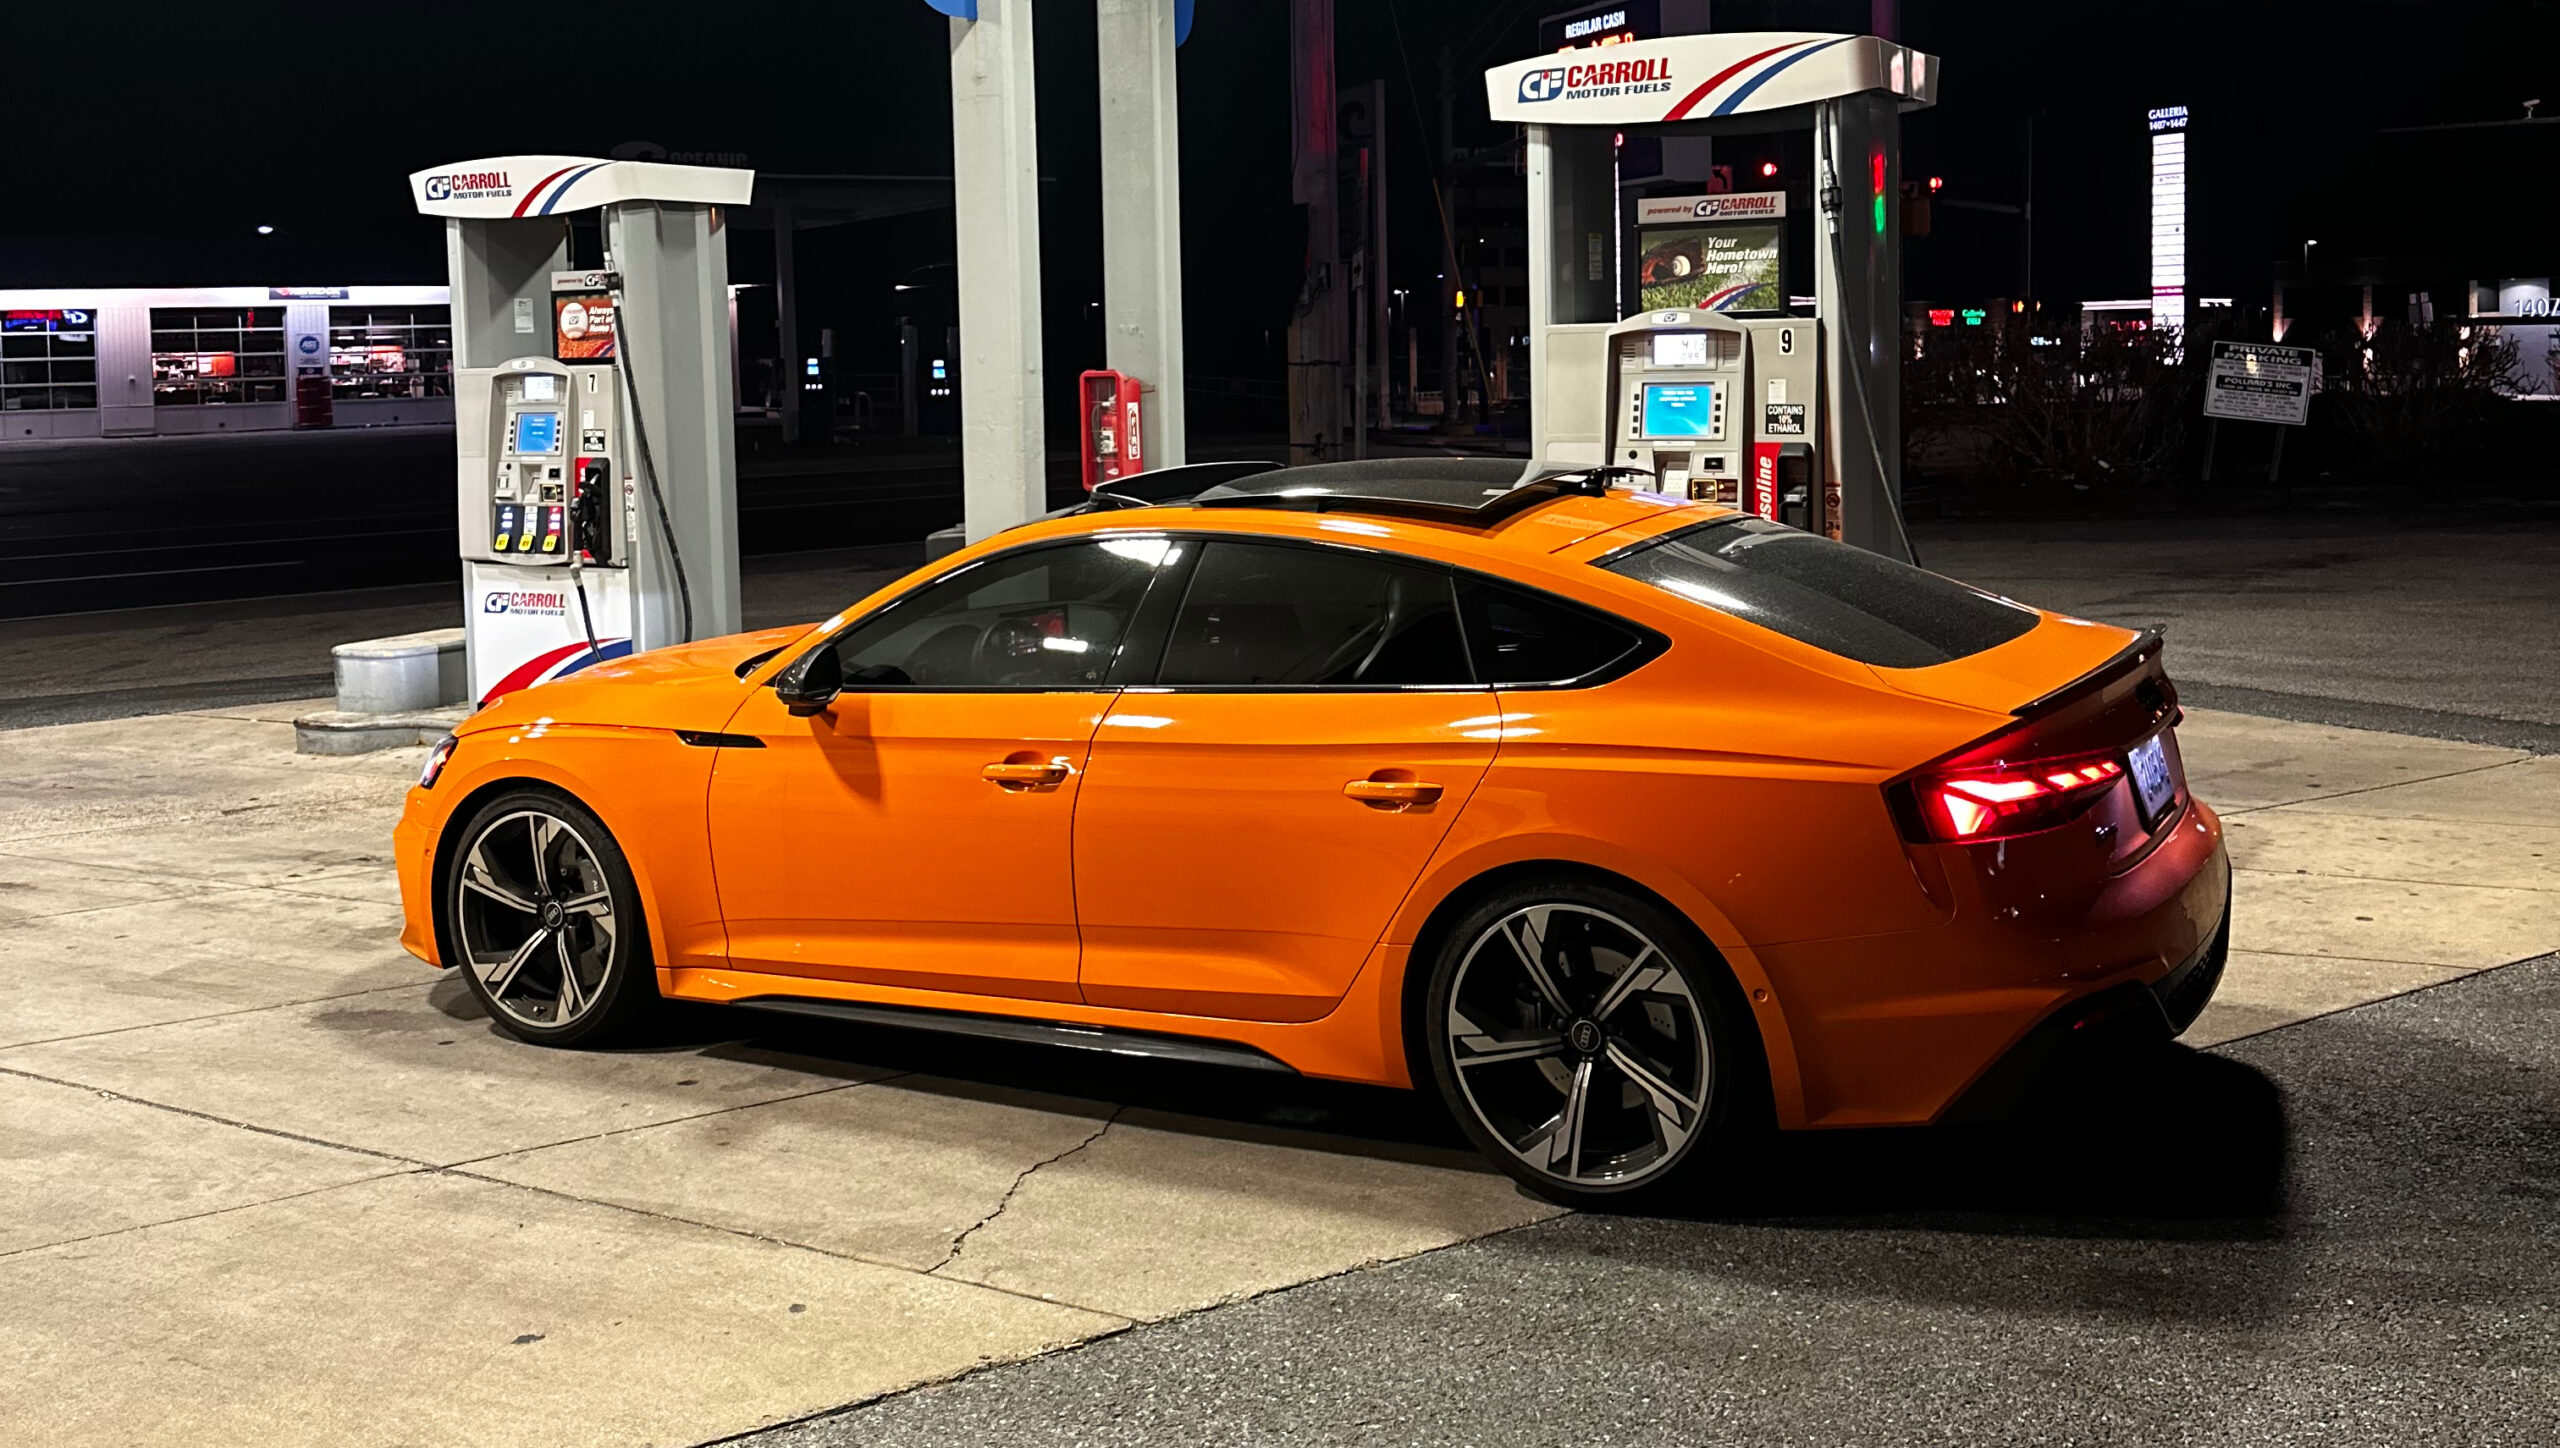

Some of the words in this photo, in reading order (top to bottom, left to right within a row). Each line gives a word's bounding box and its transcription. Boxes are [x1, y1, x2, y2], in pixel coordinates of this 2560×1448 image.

[1566, 17, 1601, 38] REGULAR
[1603, 11, 1625, 29] CASH
[1567, 58, 1672, 88] CARROLL
[1566, 86, 1620, 100] MOTOR
[1624, 82, 1671, 95] FUELS
[2148, 106, 2188, 120] GALLERIA
[452, 172, 511, 190] CARROLL
[454, 191, 483, 199] MOTOR
[486, 190, 512, 198] FUELS
[1721, 197, 1776, 210] CARROLL
[1647, 206, 1681, 215] powered
[1683, 206, 1692, 214] by
[1719, 209, 1748, 217] MOTOR
[1707, 237, 1737, 249] Your
[1706, 249, 1778, 261] Hometown
[1706, 262, 1744, 274] Hero!
[2515, 298, 2560, 317] 1407
[1781, 329, 1792, 353] 9
[2229, 344, 2298, 357] PRIVATE
[2224, 352, 2301, 365] PARKING
[589, 374, 596, 392] 7
[1768, 406, 1803, 415] CONTAINS
[1778, 414, 1793, 424] 10%
[1768, 423, 1802, 433] ETHANOL
[511, 592, 566, 608] CARROLL
